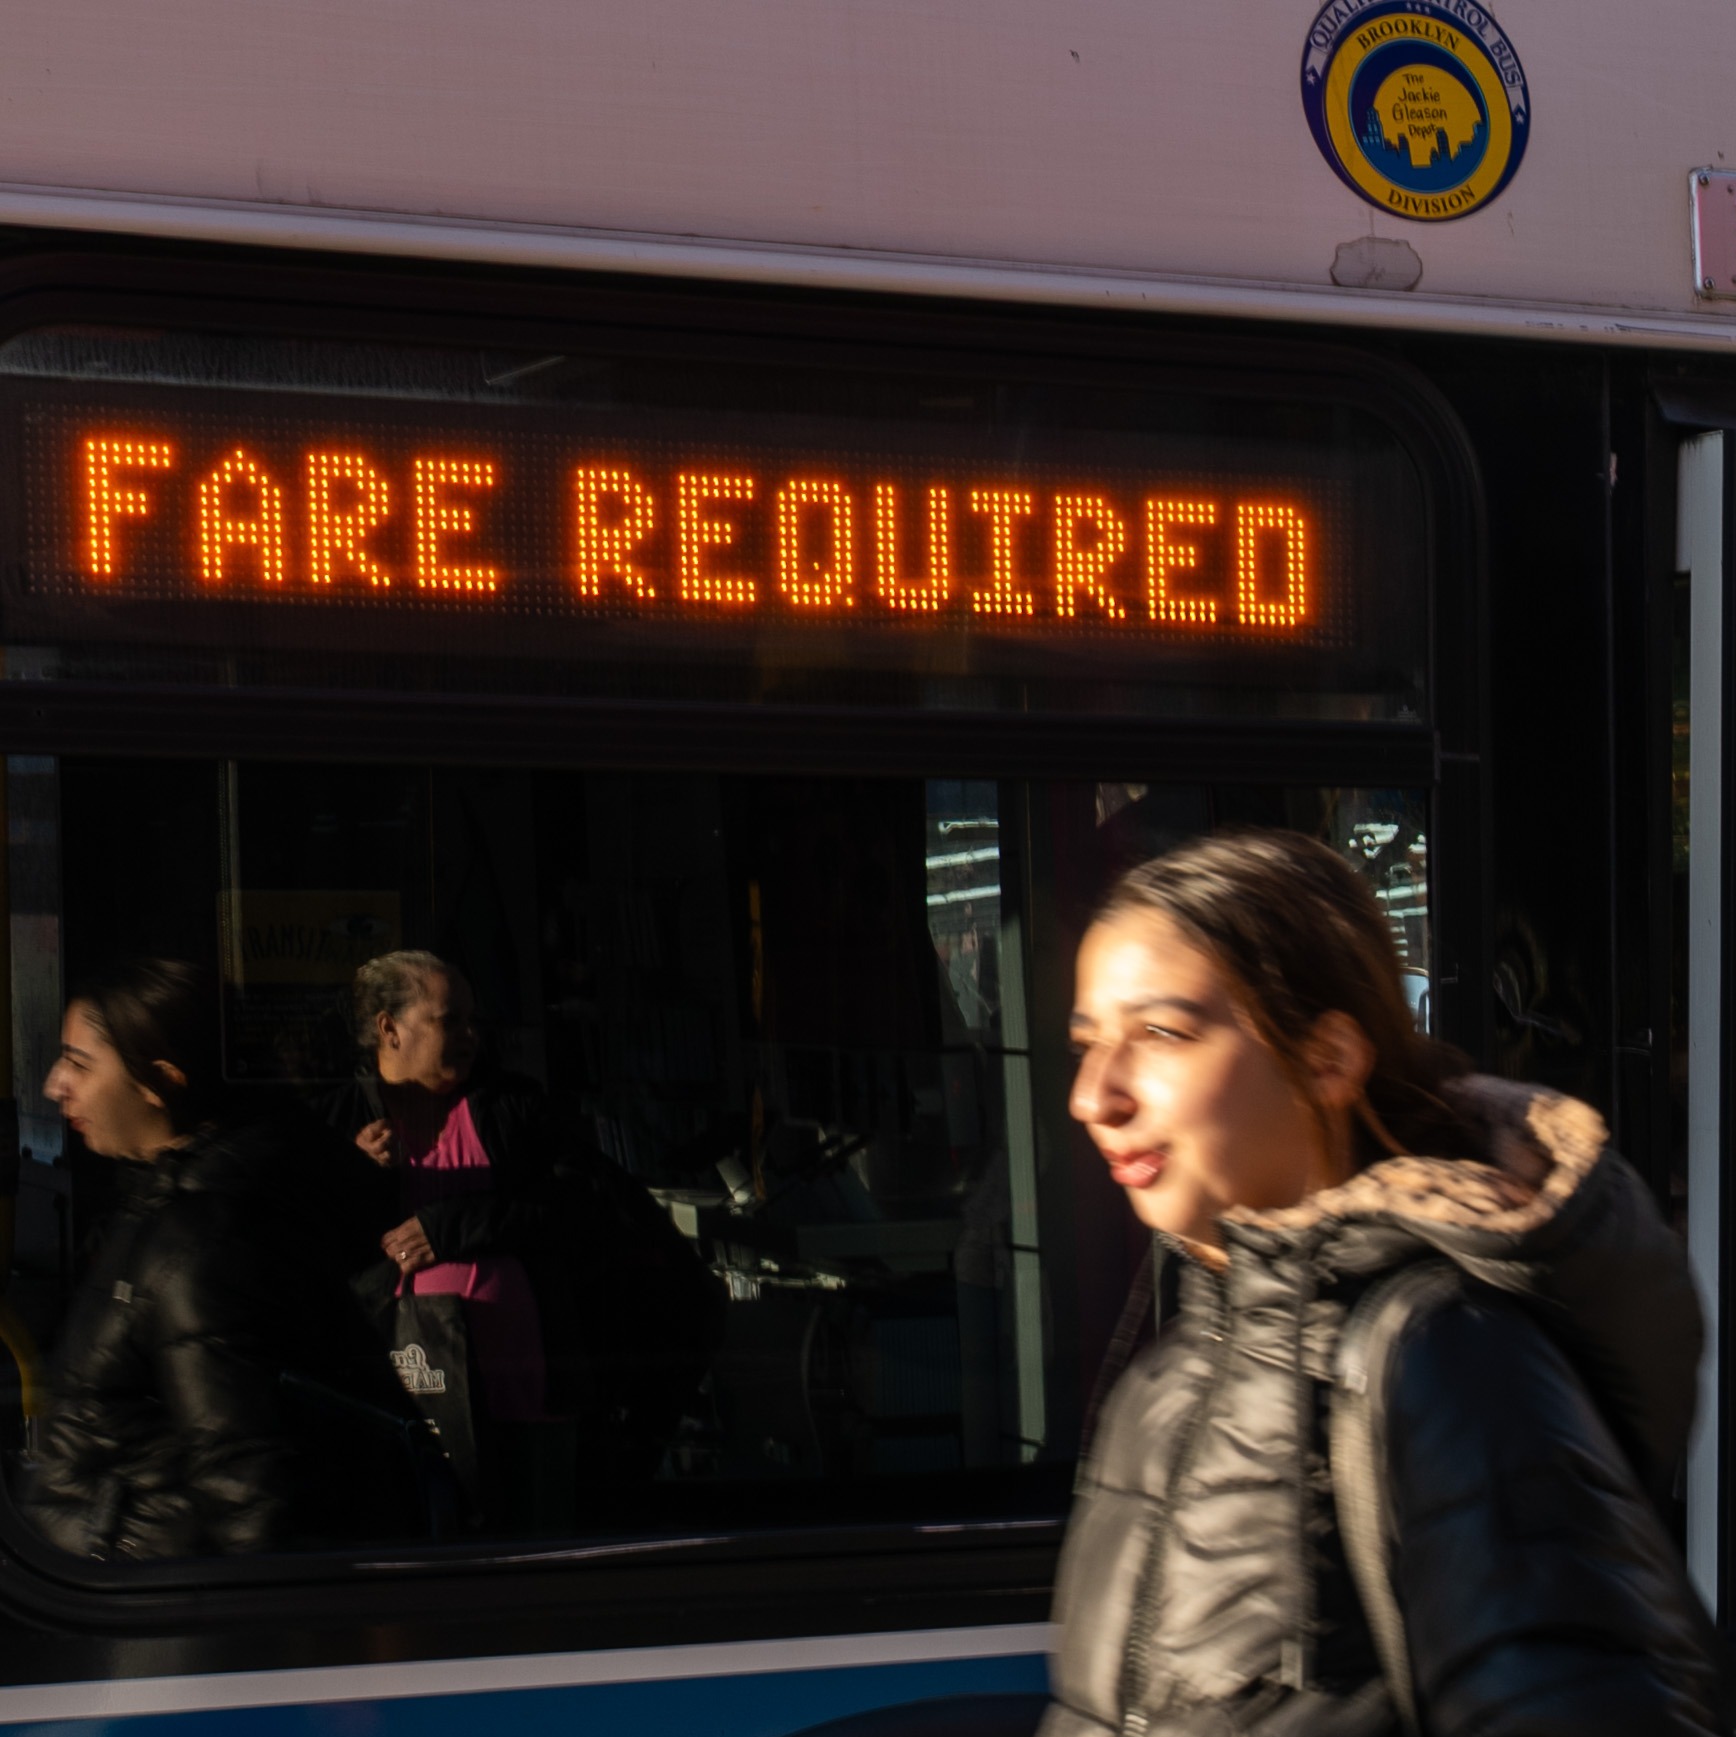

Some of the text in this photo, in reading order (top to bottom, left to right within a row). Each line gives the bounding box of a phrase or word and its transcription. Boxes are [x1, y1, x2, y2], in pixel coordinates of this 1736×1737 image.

[1310, 0, 1371, 48] QUAL
[1490, 38, 1521, 85] BUS
[1356, 18, 1460, 52] BROOKLYN
[1398, 87, 1441, 103] Jackie
[1402, 73, 1424, 86] The
[1392, 103, 1448, 122] Gleason
[1388, 184, 1477, 215] DIVISION
[85, 439, 1307, 627] FARE REQUIRED
